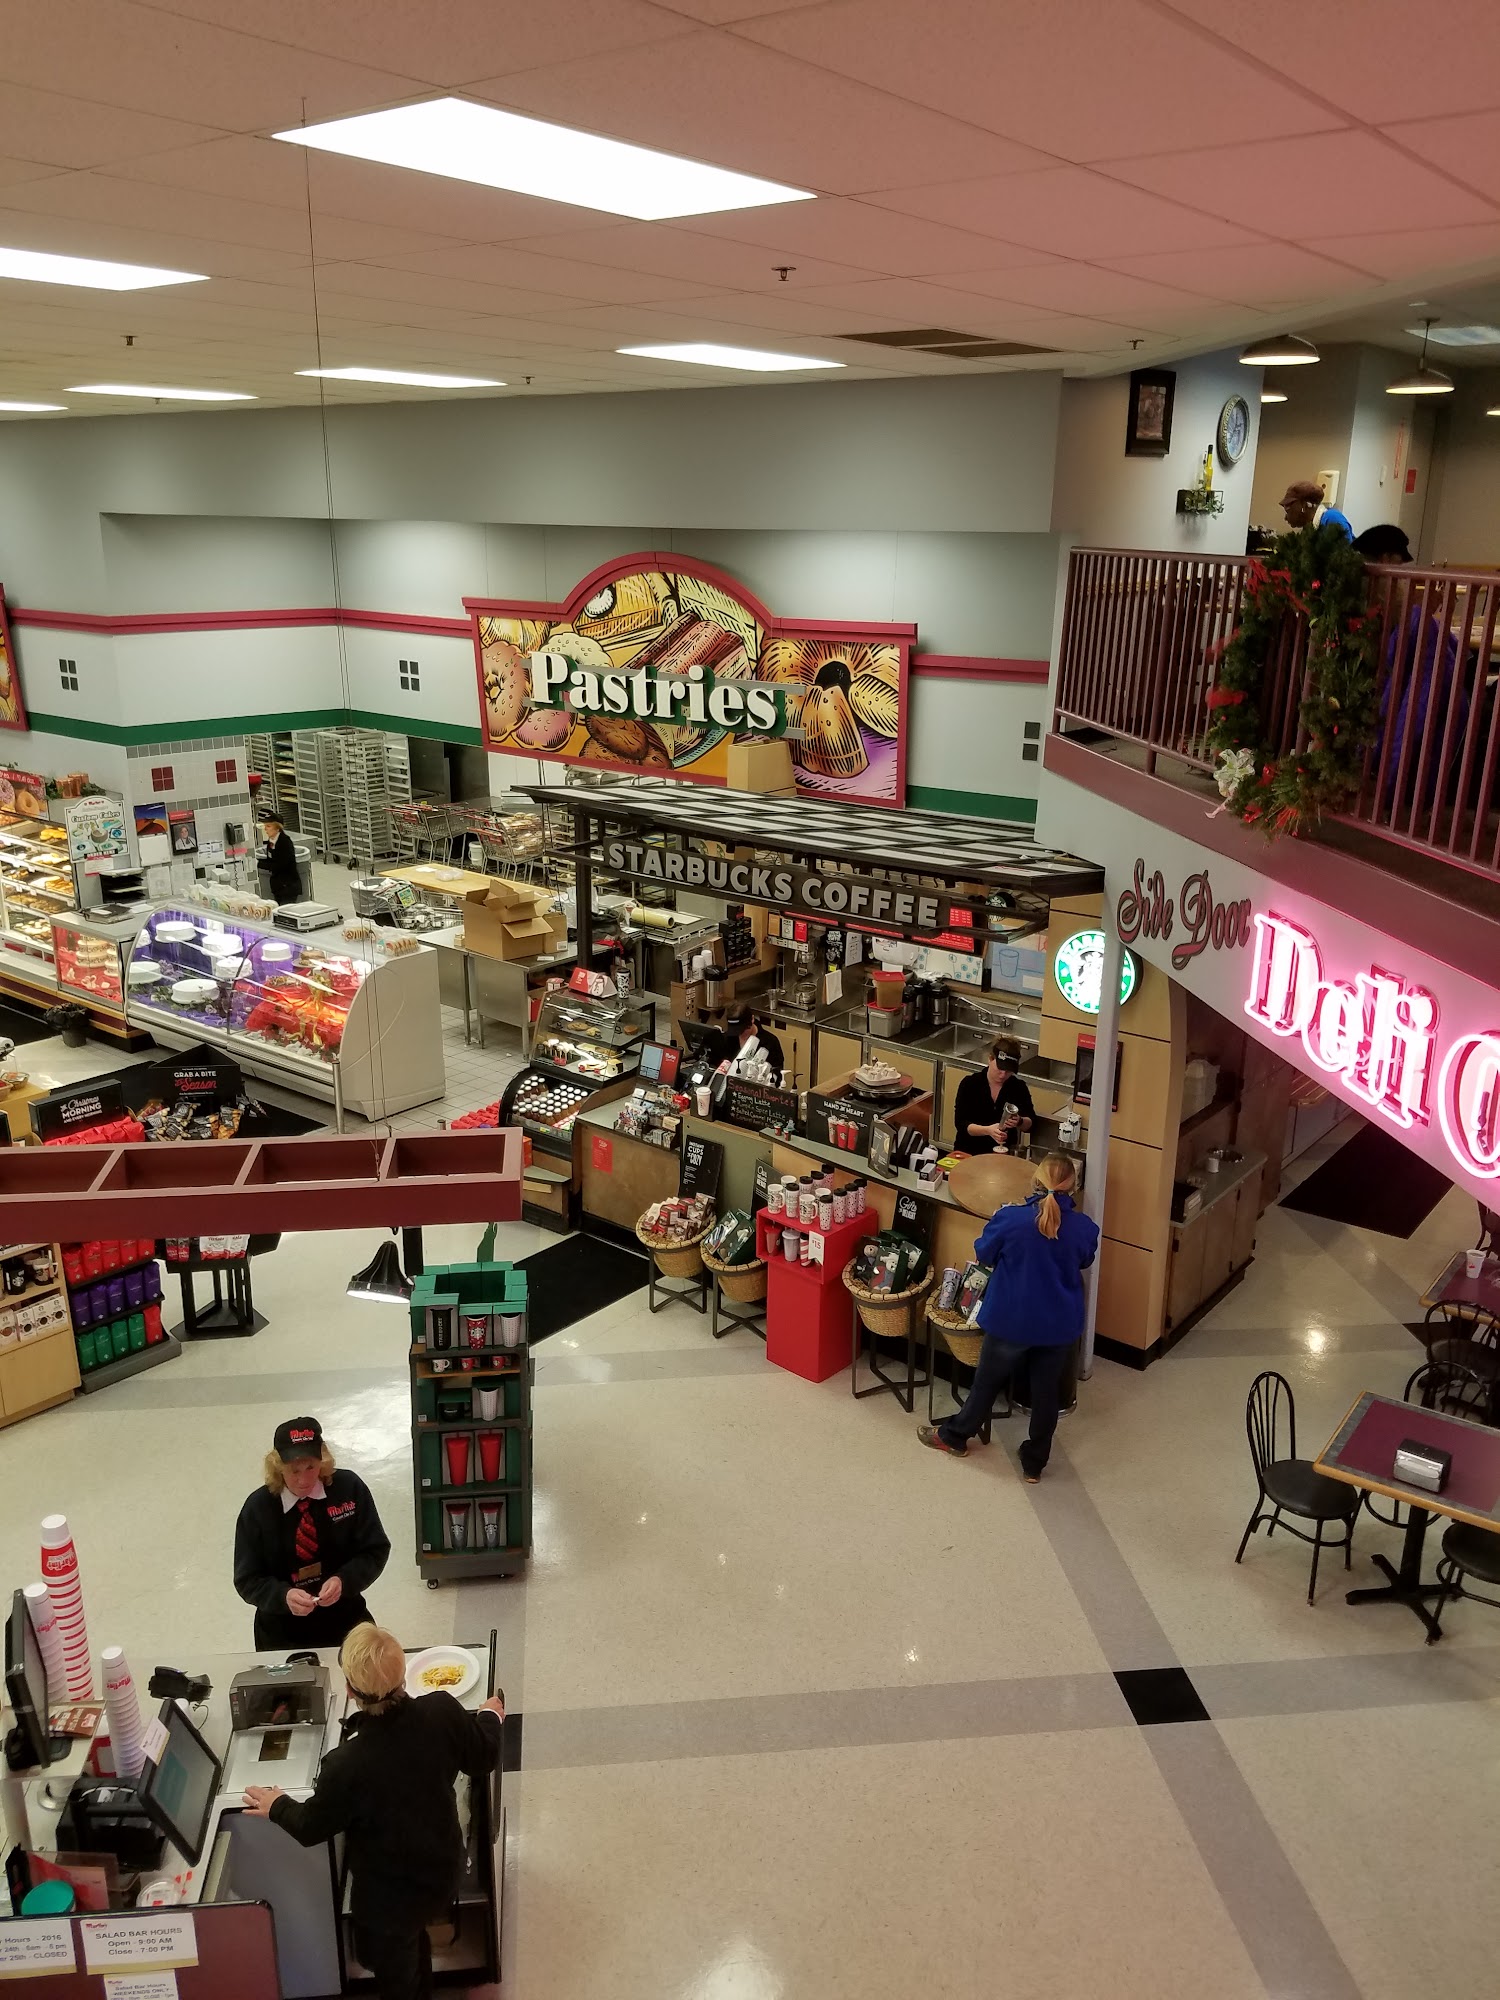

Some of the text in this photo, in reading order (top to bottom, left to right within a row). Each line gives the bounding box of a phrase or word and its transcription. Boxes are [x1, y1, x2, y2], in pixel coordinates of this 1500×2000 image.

[528, 650, 779, 731] Pastries
[607, 842, 939, 928] STARBUCKS COFFEE
[1116, 857, 1252, 971] Side Door
[1244, 909, 1441, 1130] Deli
[181, 1077, 217, 1091] Season
[727, 1078, 762, 1098] Seasonal
[68, 1096, 100, 1110] Christmas
[754, 1097, 771, 1108] Latte
[823, 1100, 840, 1110] HAND
[846, 1107, 866, 1118] HEART
[62, 1102, 102, 1119] MORNING
[769, 1109, 786, 1120] Latte
[688, 1146, 704, 1156] CUPS
[811, 1239, 822, 1251] $15
[327, 1501, 356, 1518] Martin's
[37, 1618, 57, 1633] artin's
[41, 1934, 62, 1942] 2016
[96, 1931, 126, 1939] SALAD
[150, 1927, 183, 1935] HOURS
[107, 1940, 131, 1948] Open
[140, 1946, 159, 1954] 7:00
[33, 1951, 68, 1959] CLOSED
